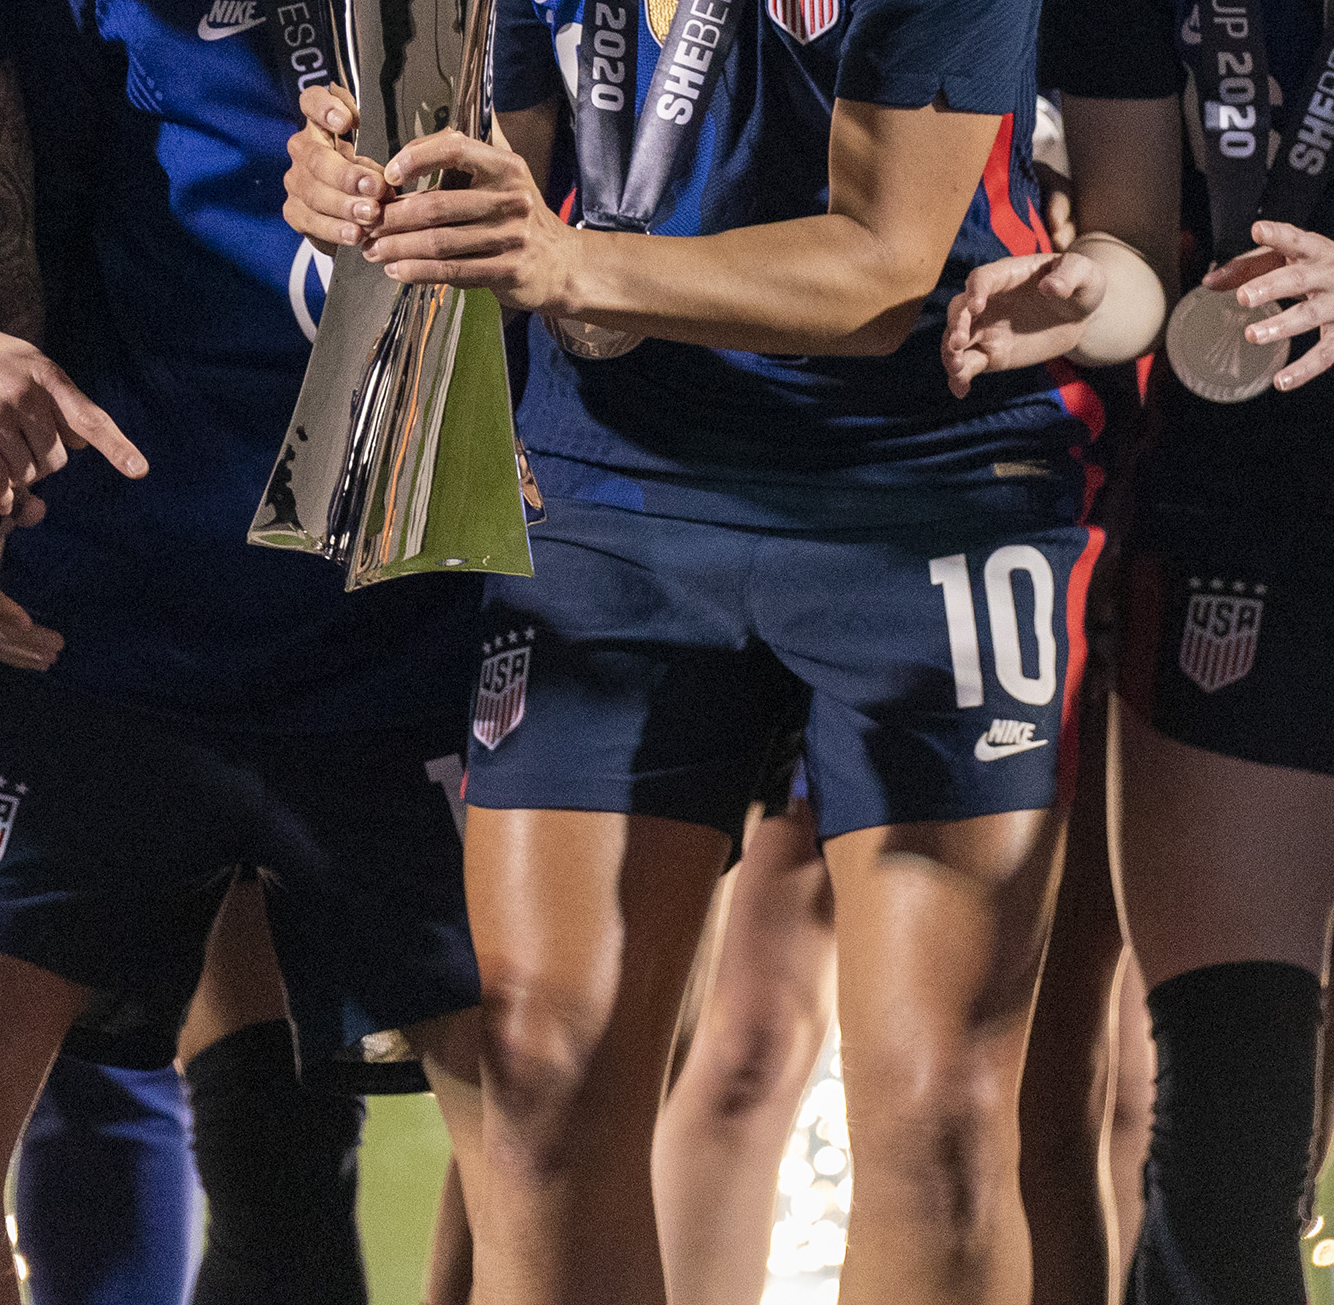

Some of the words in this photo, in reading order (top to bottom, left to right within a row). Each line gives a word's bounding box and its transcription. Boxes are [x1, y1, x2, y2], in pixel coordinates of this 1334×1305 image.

[208, 0, 258, 23] NIKE
[590, 3, 627, 112] 2020
[1217, 52, 1256, 159] 2020
[929, 545, 1056, 708] 10
[1194, 601, 1259, 637] USA
[482, 654, 527, 693] USA
[987, 720, 1036, 743] NIKE
